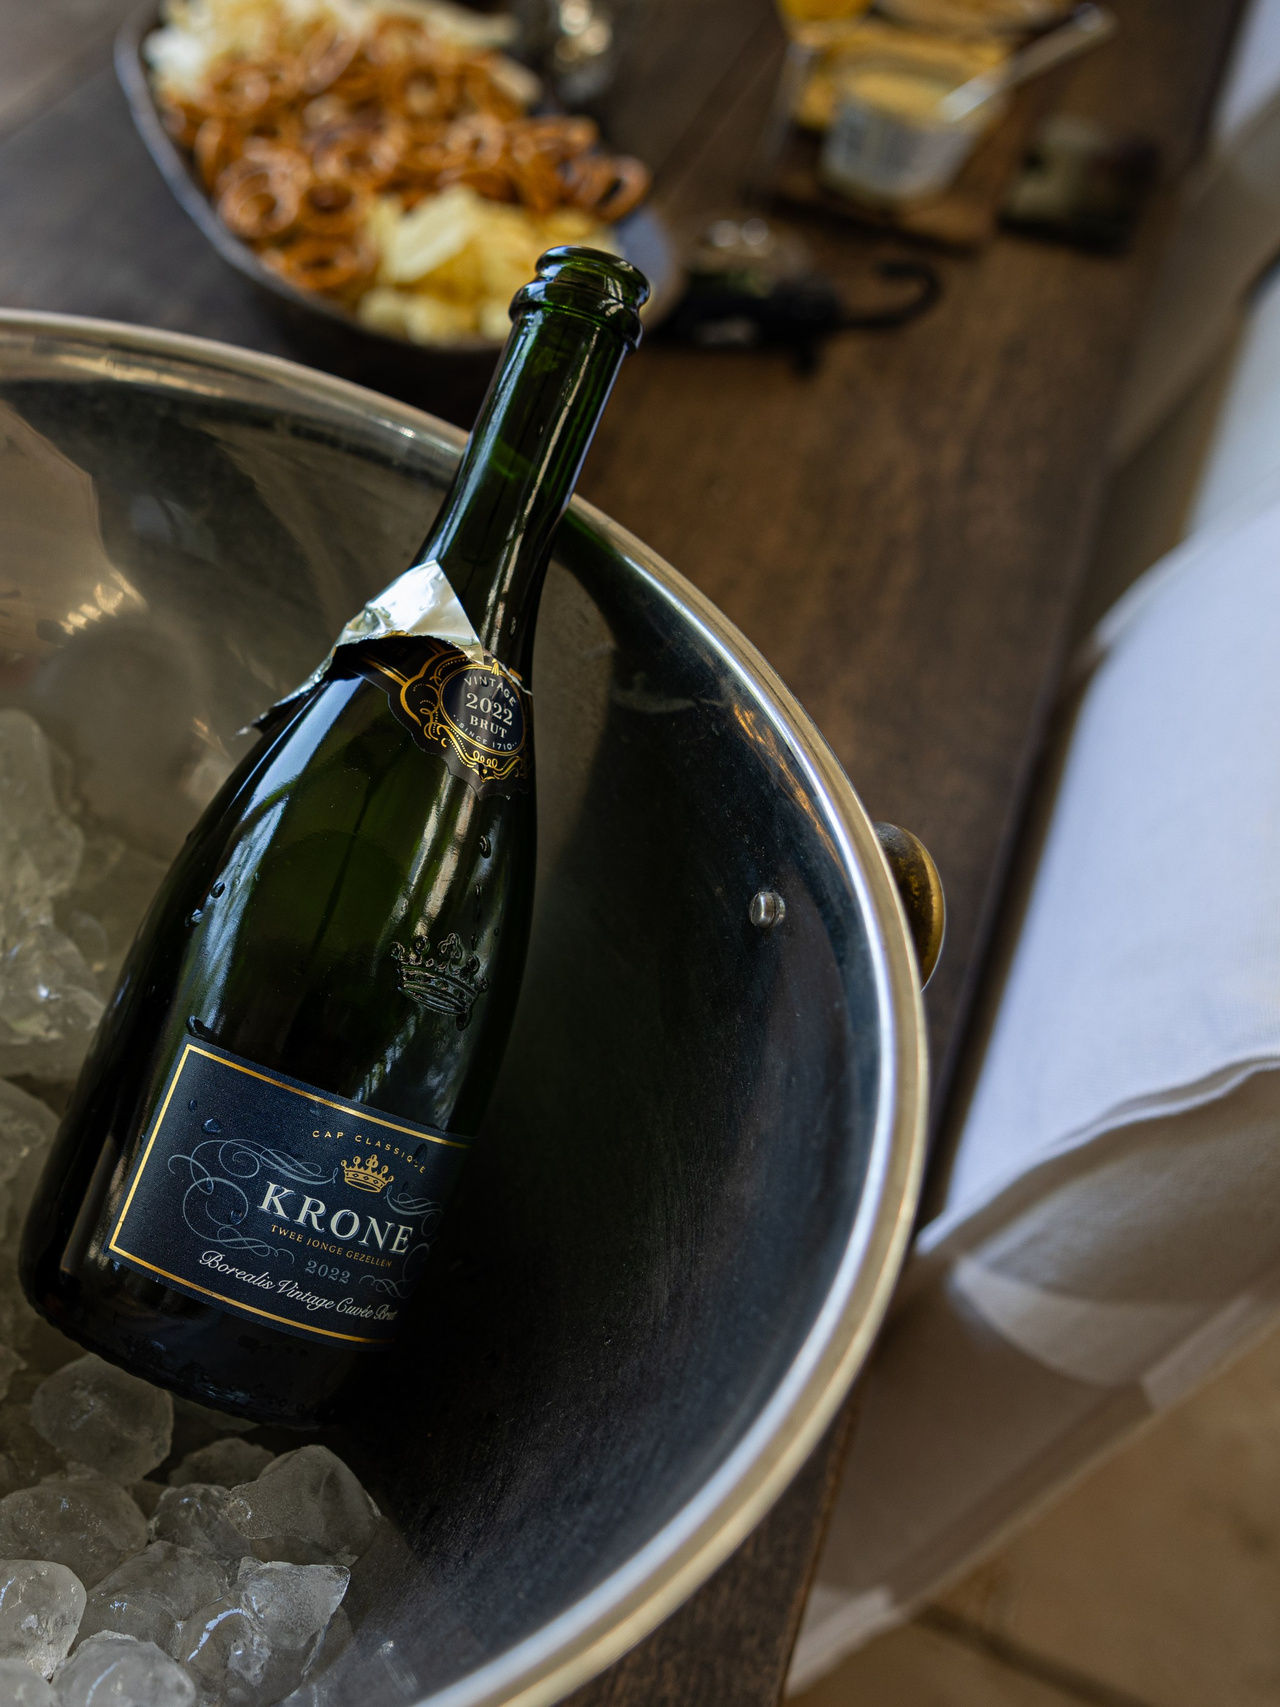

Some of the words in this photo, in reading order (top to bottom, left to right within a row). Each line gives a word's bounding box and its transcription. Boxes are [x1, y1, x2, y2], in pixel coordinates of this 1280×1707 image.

[463, 675, 517, 707] VINTAGE
[465, 692, 513, 726] 2022
[458, 722, 488, 746] SINCE
[492, 741, 513, 751] 1710
[470, 715, 508, 739] BRUT
[312, 1130, 344, 1139] CAP
[256, 1181, 414, 1256] KRONE
[270, 1224, 303, 1243] TWEE
[305, 1237, 343, 1256] JONGE
[345, 1250, 393, 1268] GEZELLEN
[198, 1249, 276, 1290] Borealis
[277, 1279, 336, 1311] Vintage
[336, 1297, 374, 1320] Cuvée
[304, 1260, 351, 1284] 2022
